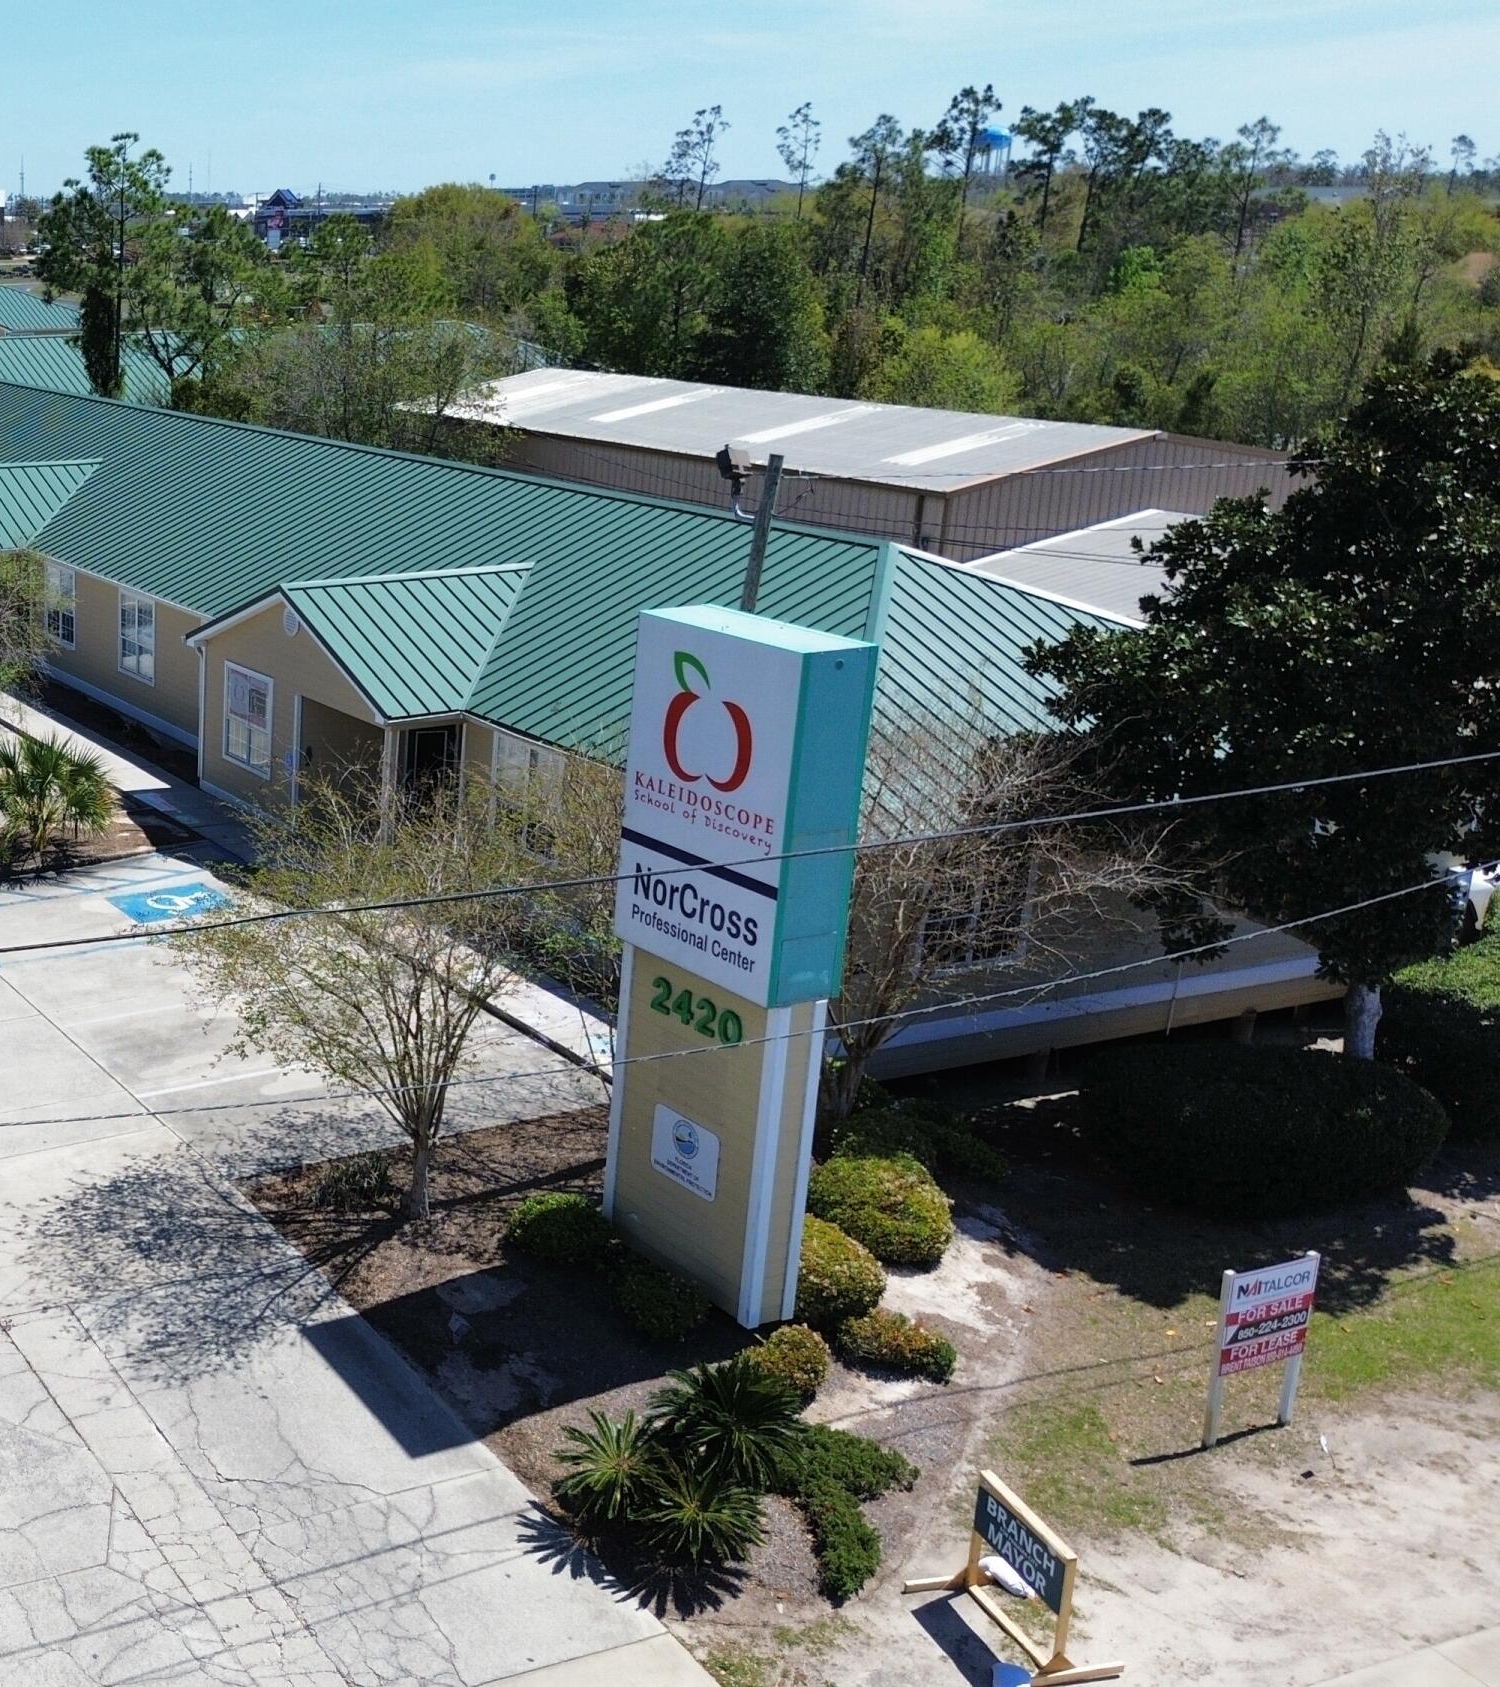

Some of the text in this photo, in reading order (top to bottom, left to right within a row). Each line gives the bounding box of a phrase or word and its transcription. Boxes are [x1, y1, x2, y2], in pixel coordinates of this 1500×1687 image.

[634, 770, 775, 836] KALEIDOSCOPE
[634, 788, 772, 856] School of Discovery
[631, 904, 756, 974] Professional Center
[633, 862, 759, 947] NorCross
[650, 976, 743, 1046] 2420
[1238, 1305, 1267, 1324] FOR
[1269, 1296, 1303, 1316] SALE
[1238, 1310, 1307, 1340] 850-224-2300
[1229, 1331, 1298, 1361] FOR LEASE
[987, 1495, 1055, 1577] BRANCH
[988, 1522, 1046, 1597] MAYOR
